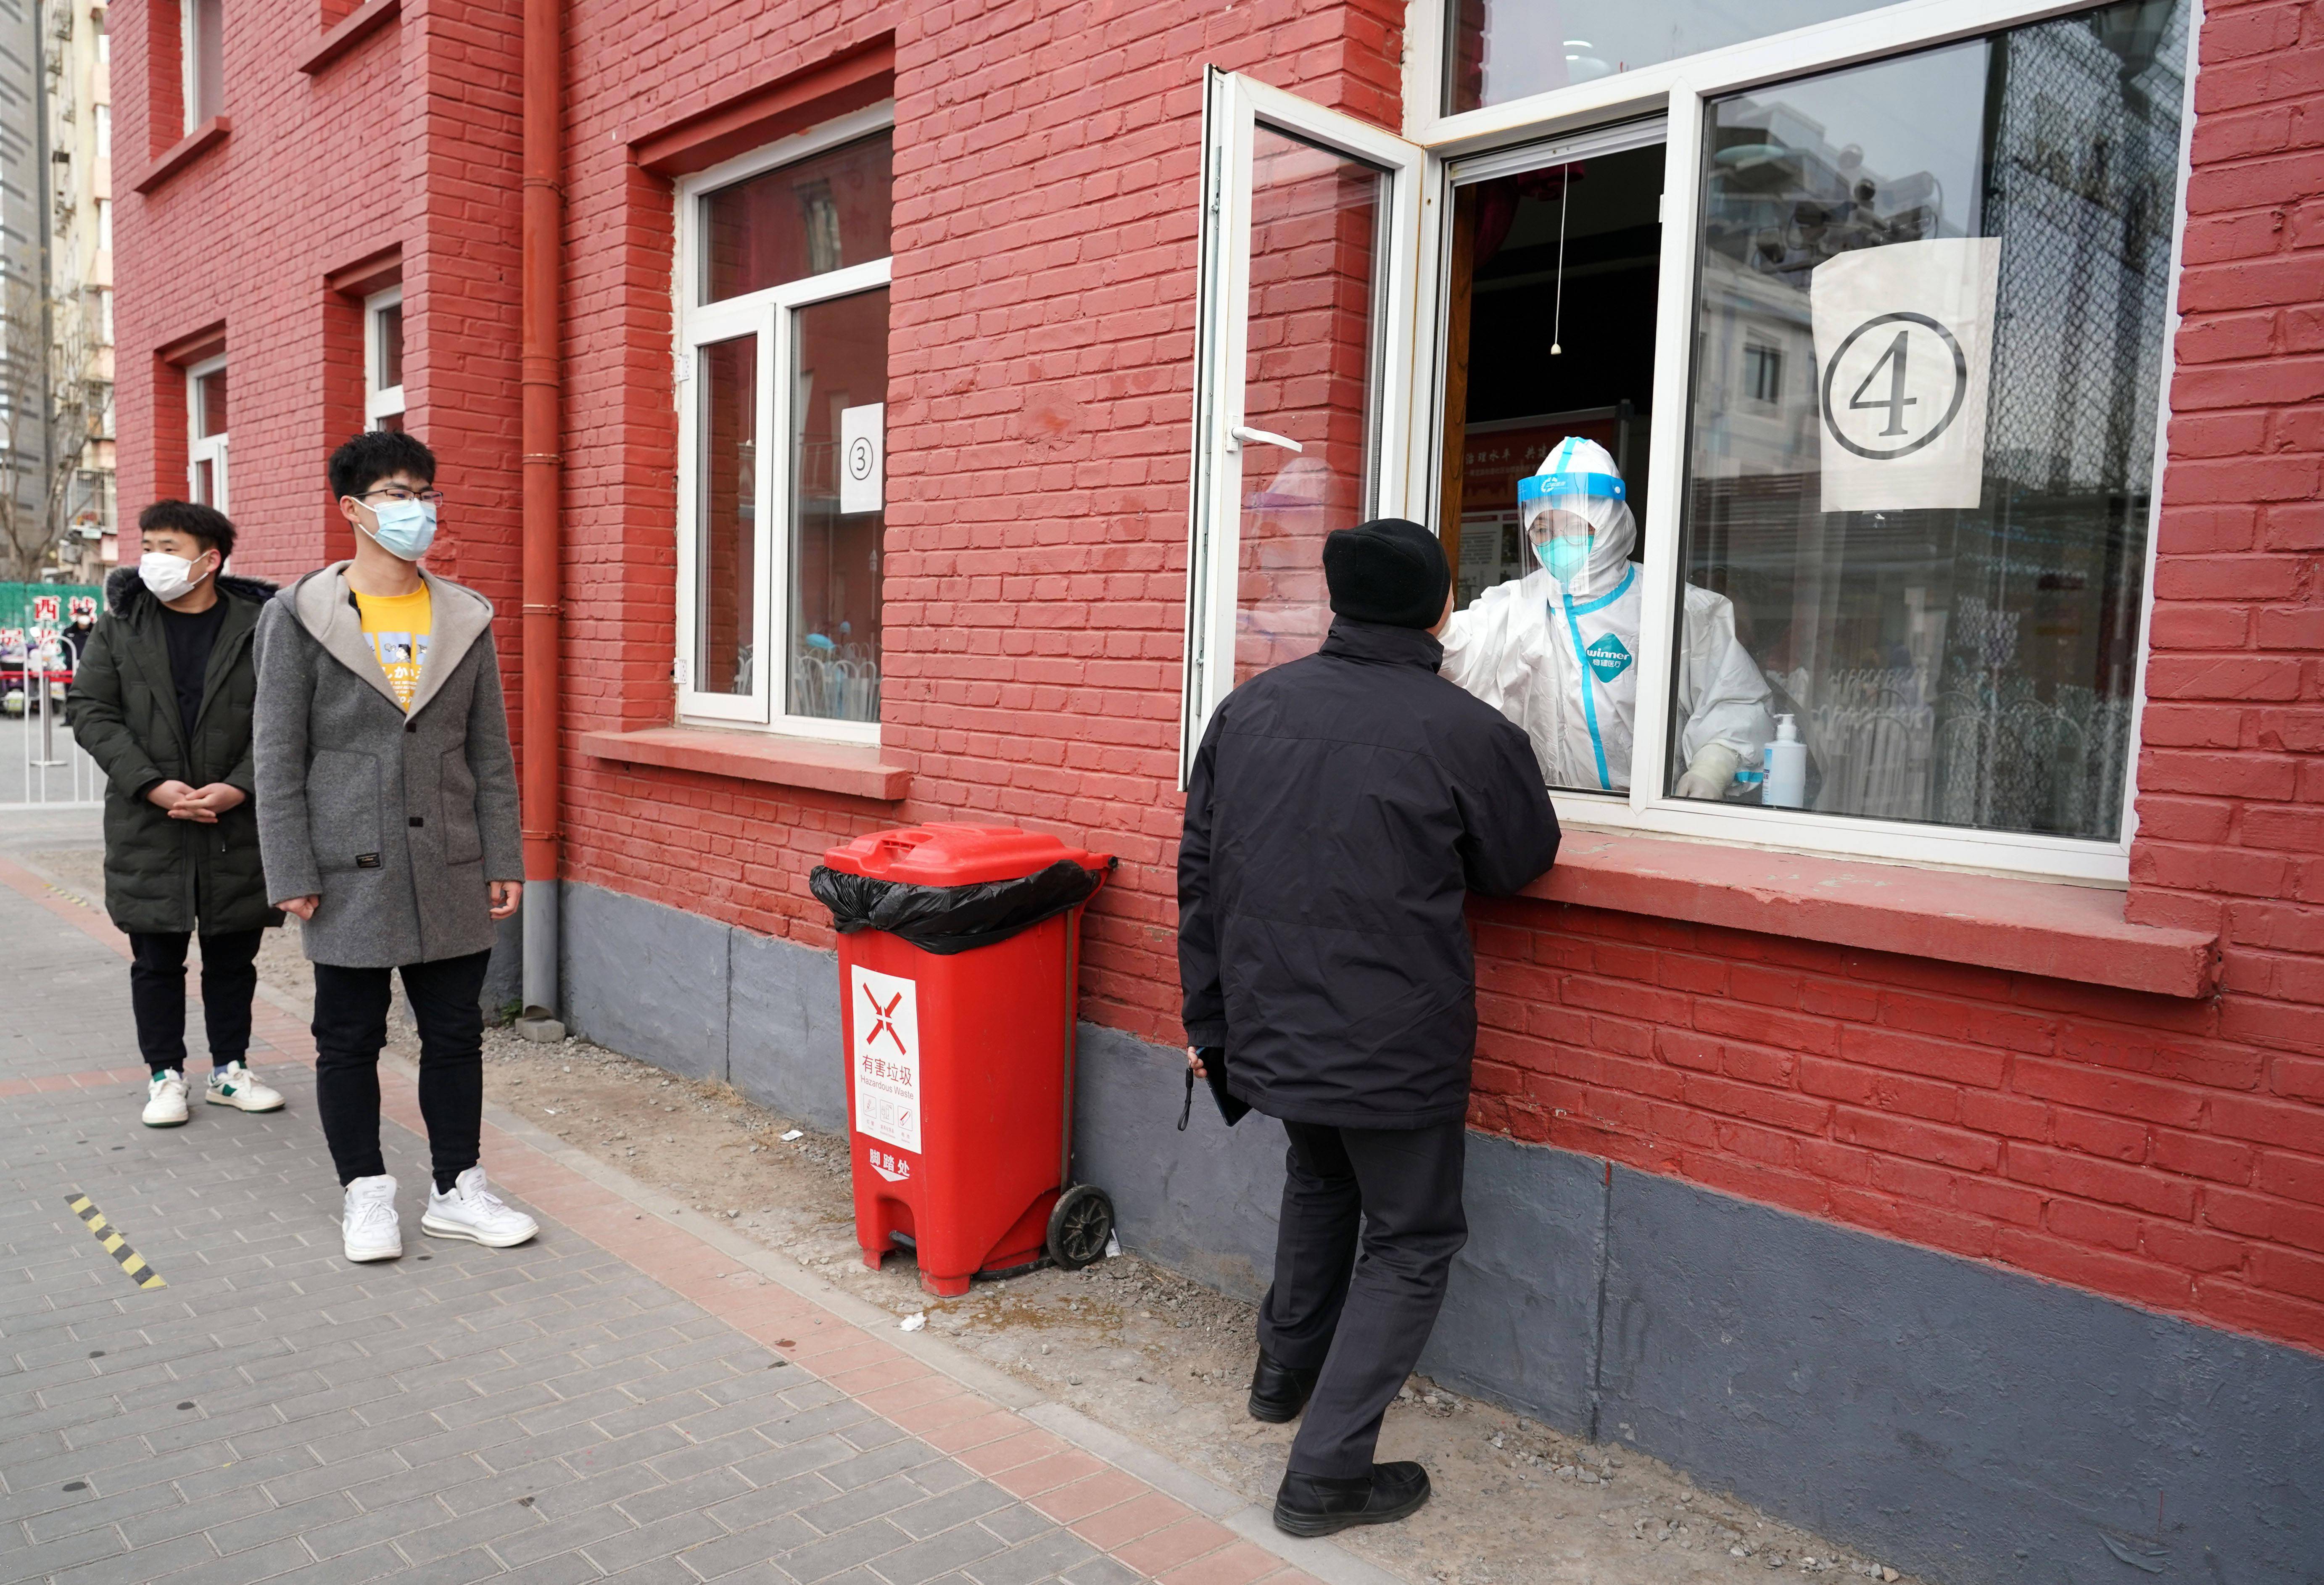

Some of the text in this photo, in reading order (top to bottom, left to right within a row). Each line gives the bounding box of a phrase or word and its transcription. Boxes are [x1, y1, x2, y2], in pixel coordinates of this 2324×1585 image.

[1588, 648, 1630, 660] winner
[863, 1054, 912, 1087] 有害垃圾
[861, 1075, 914, 1100] Hazardous Waste
[870, 1148, 910, 1176] 脚踏处
